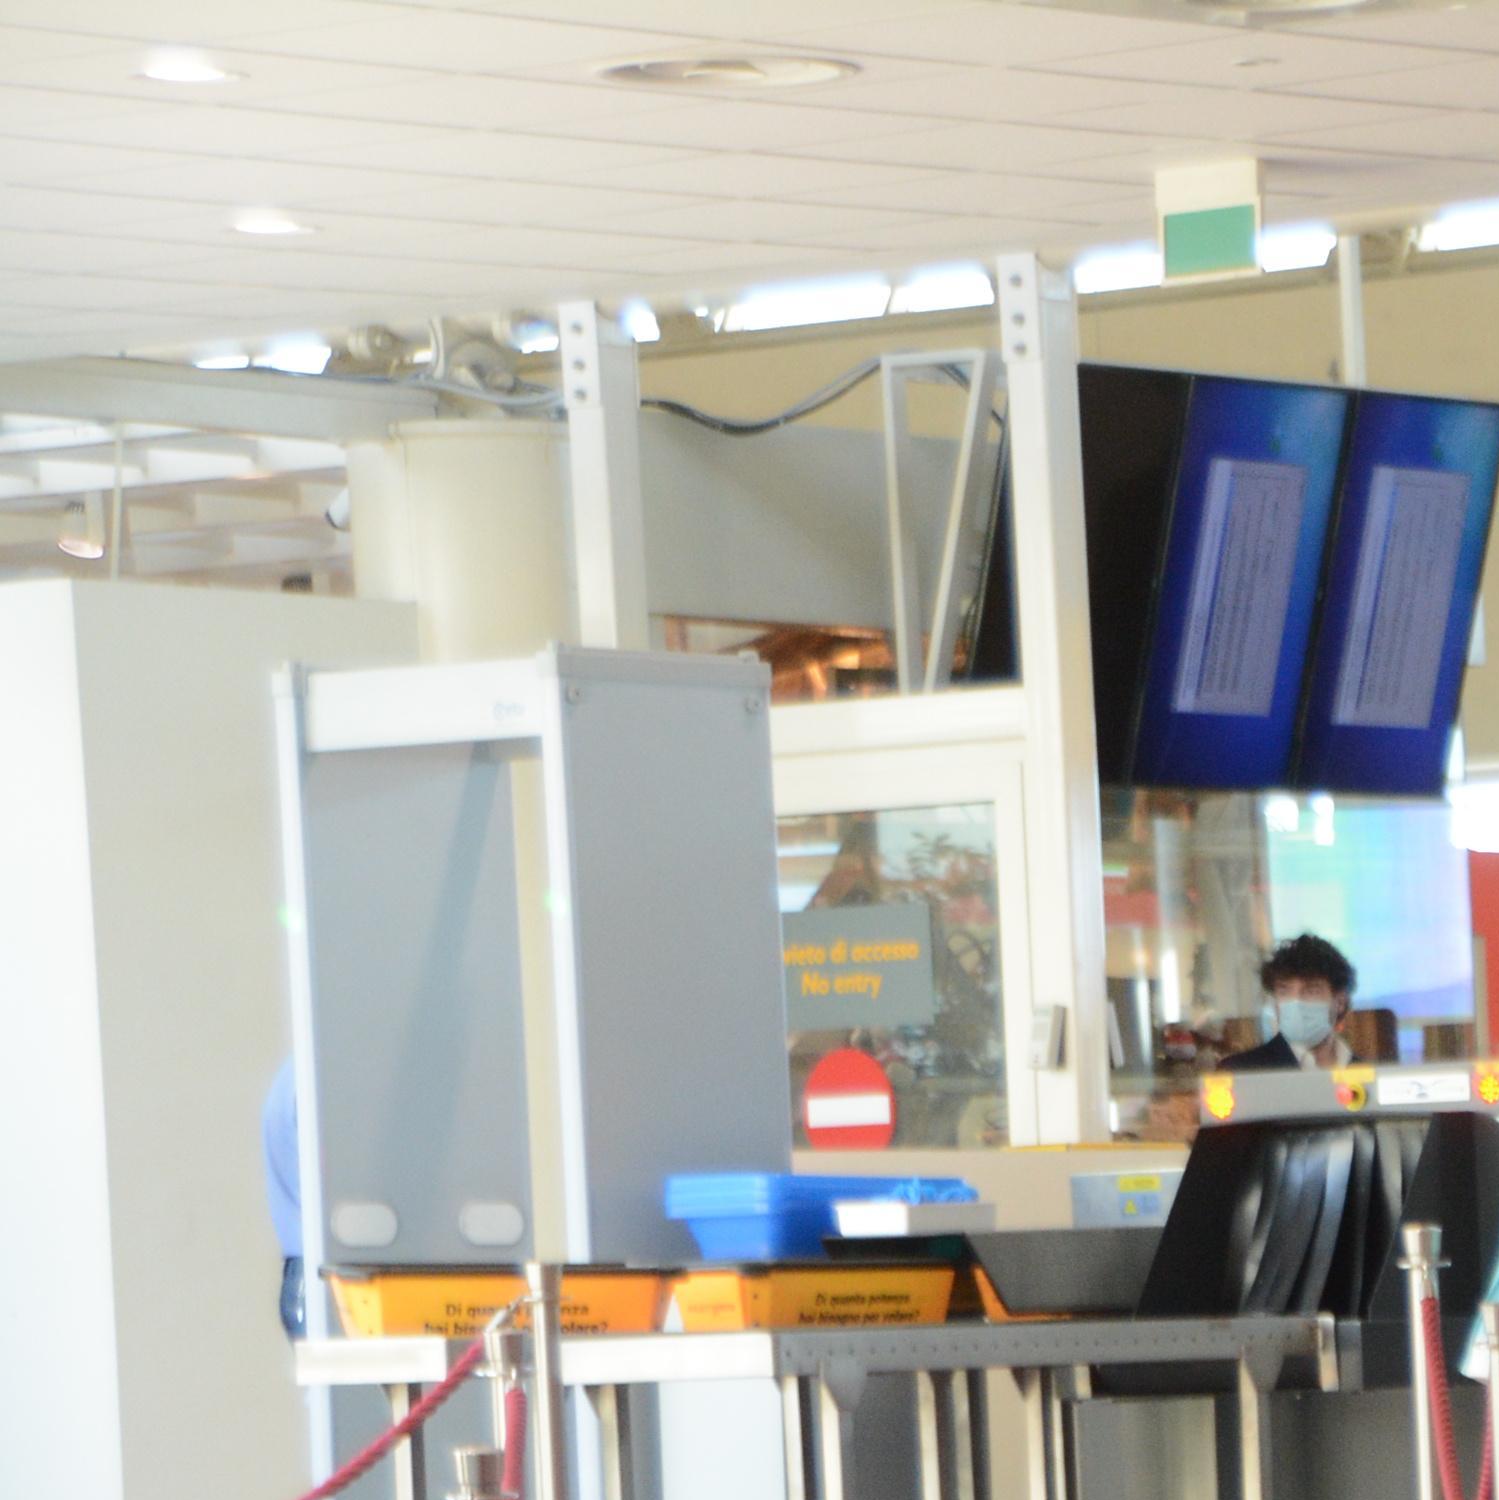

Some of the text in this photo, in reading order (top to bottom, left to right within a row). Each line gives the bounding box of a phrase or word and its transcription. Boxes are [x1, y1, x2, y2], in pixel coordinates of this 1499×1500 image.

[831, 938, 848, 964] di
[851, 941, 919, 962] accesso
[802, 971, 883, 1001] No entry
[446, 1303, 462, 1317] Di
[560, 1321, 608, 1335] olare?
